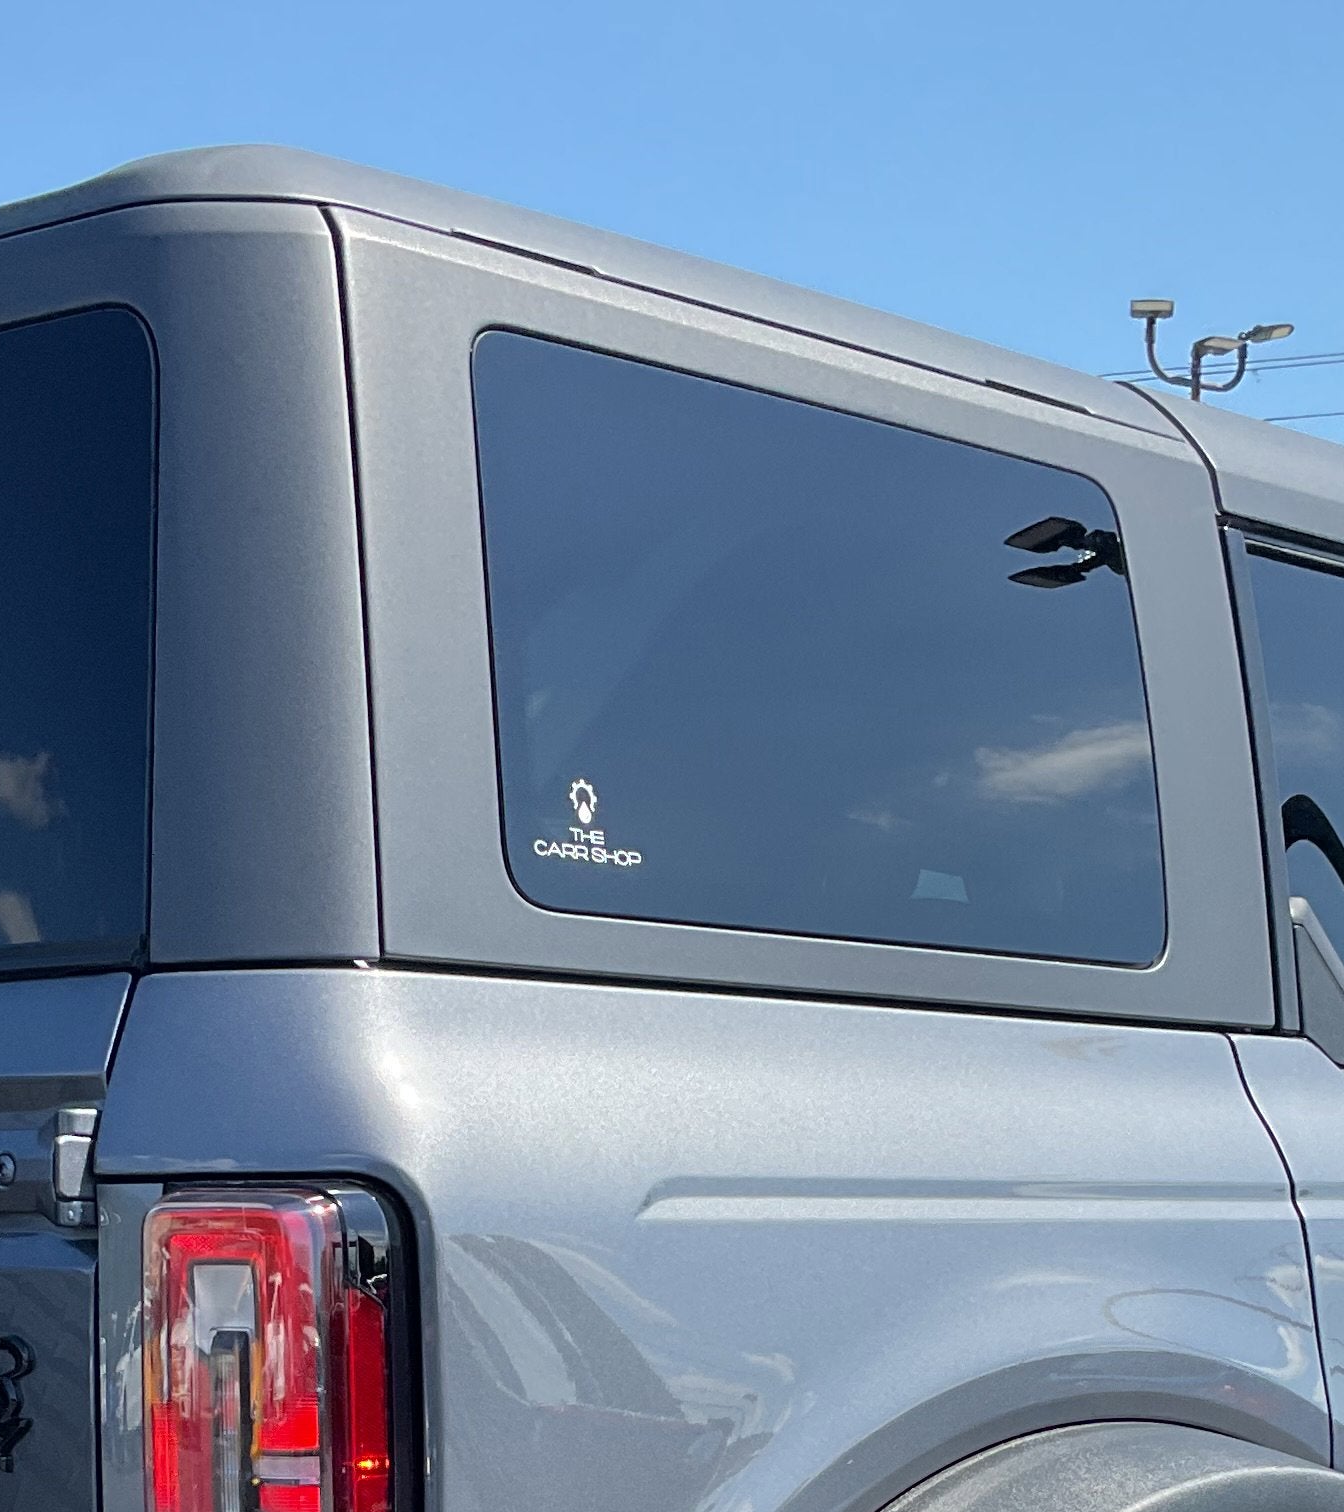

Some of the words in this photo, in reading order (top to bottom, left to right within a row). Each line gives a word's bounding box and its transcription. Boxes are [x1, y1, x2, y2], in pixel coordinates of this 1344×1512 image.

[569, 827, 605, 845] THE
[534, 839, 589, 861] CARR
[591, 847, 642, 866] SHOP
